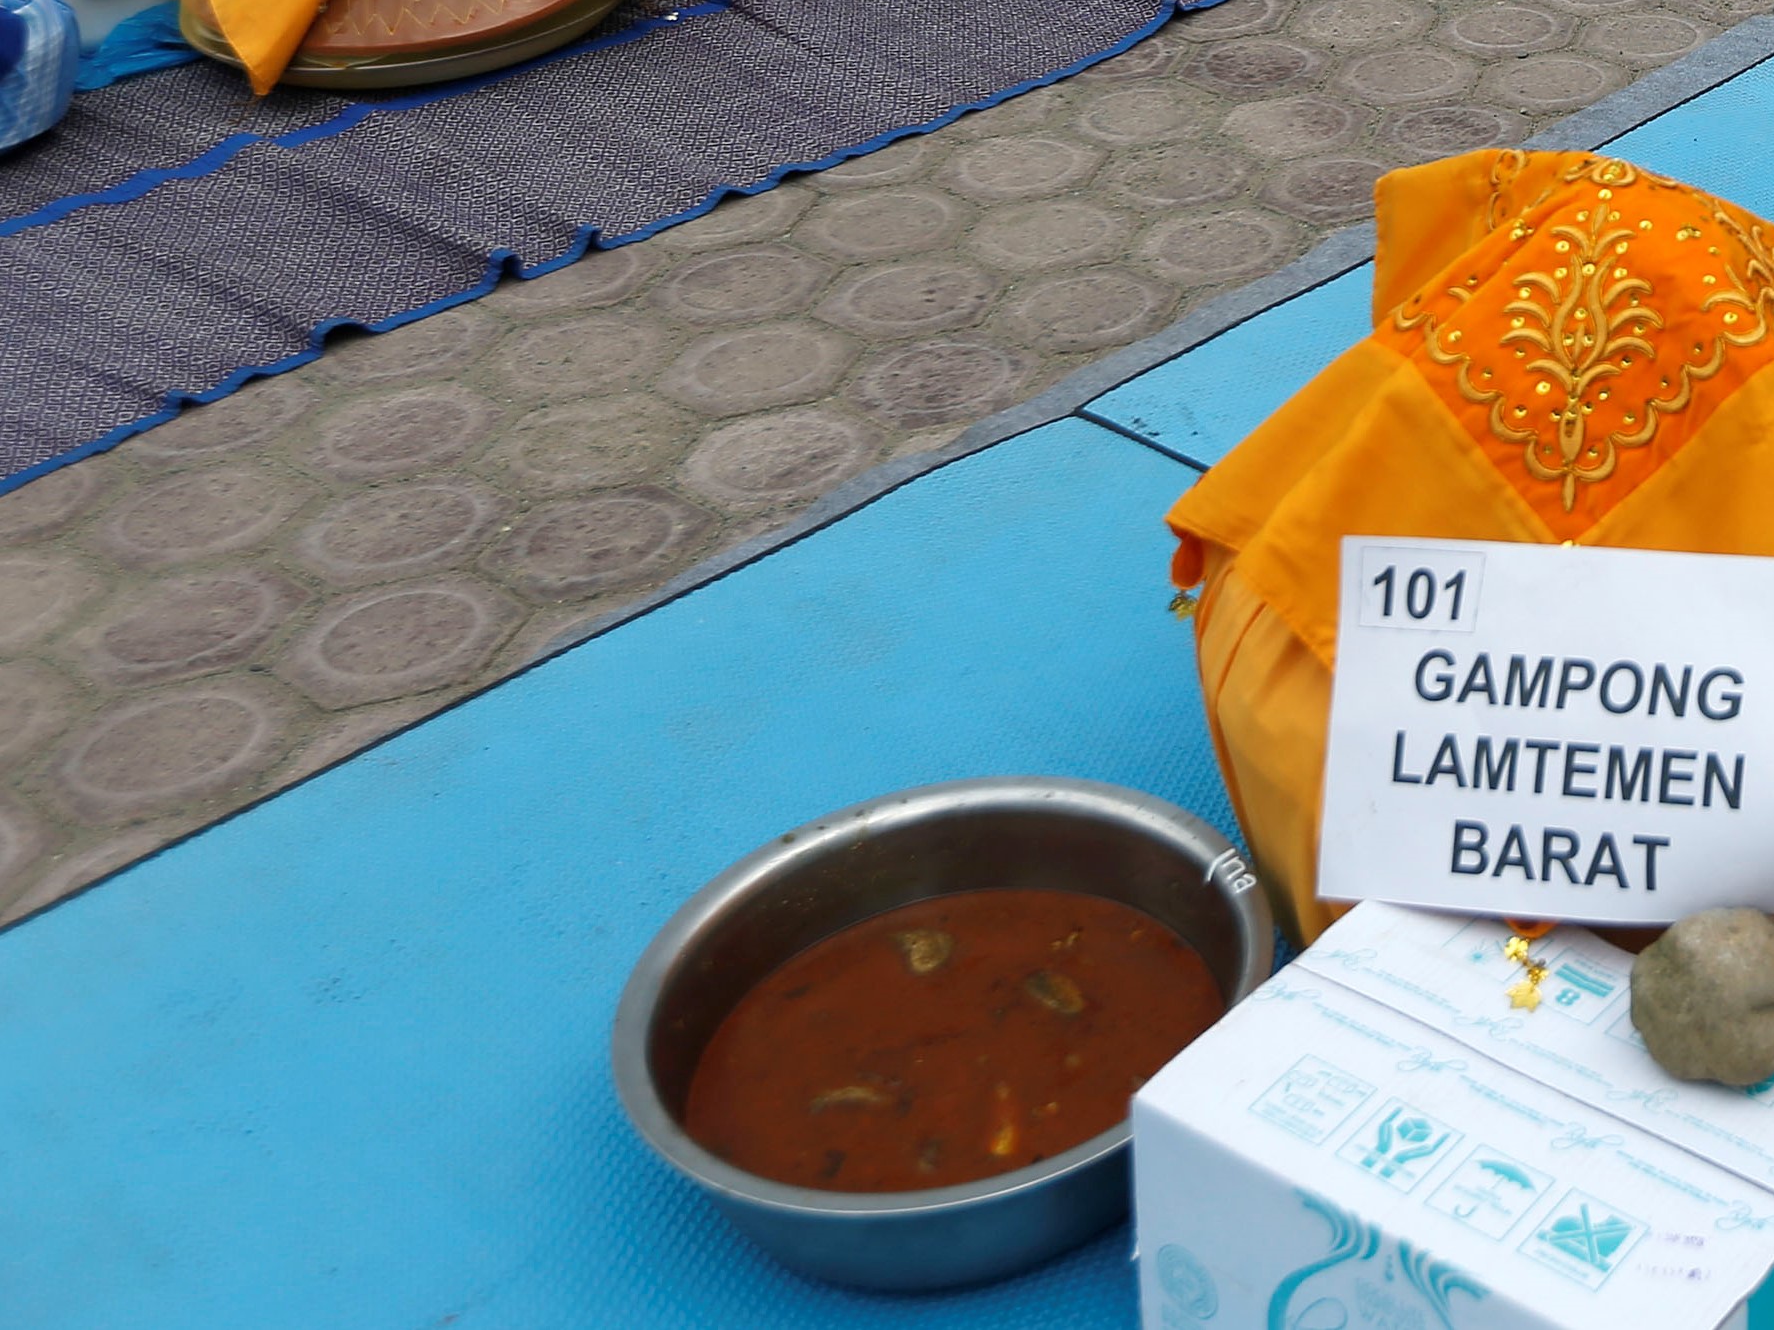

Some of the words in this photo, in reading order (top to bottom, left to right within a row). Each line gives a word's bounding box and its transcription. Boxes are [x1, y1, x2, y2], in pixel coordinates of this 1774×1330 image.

[1372, 565, 1468, 621] 101
[1414, 648, 1746, 721] GAMPONG
[1391, 729, 1746, 810] LAMTEMEN
[1450, 819, 1672, 892] BARAT
